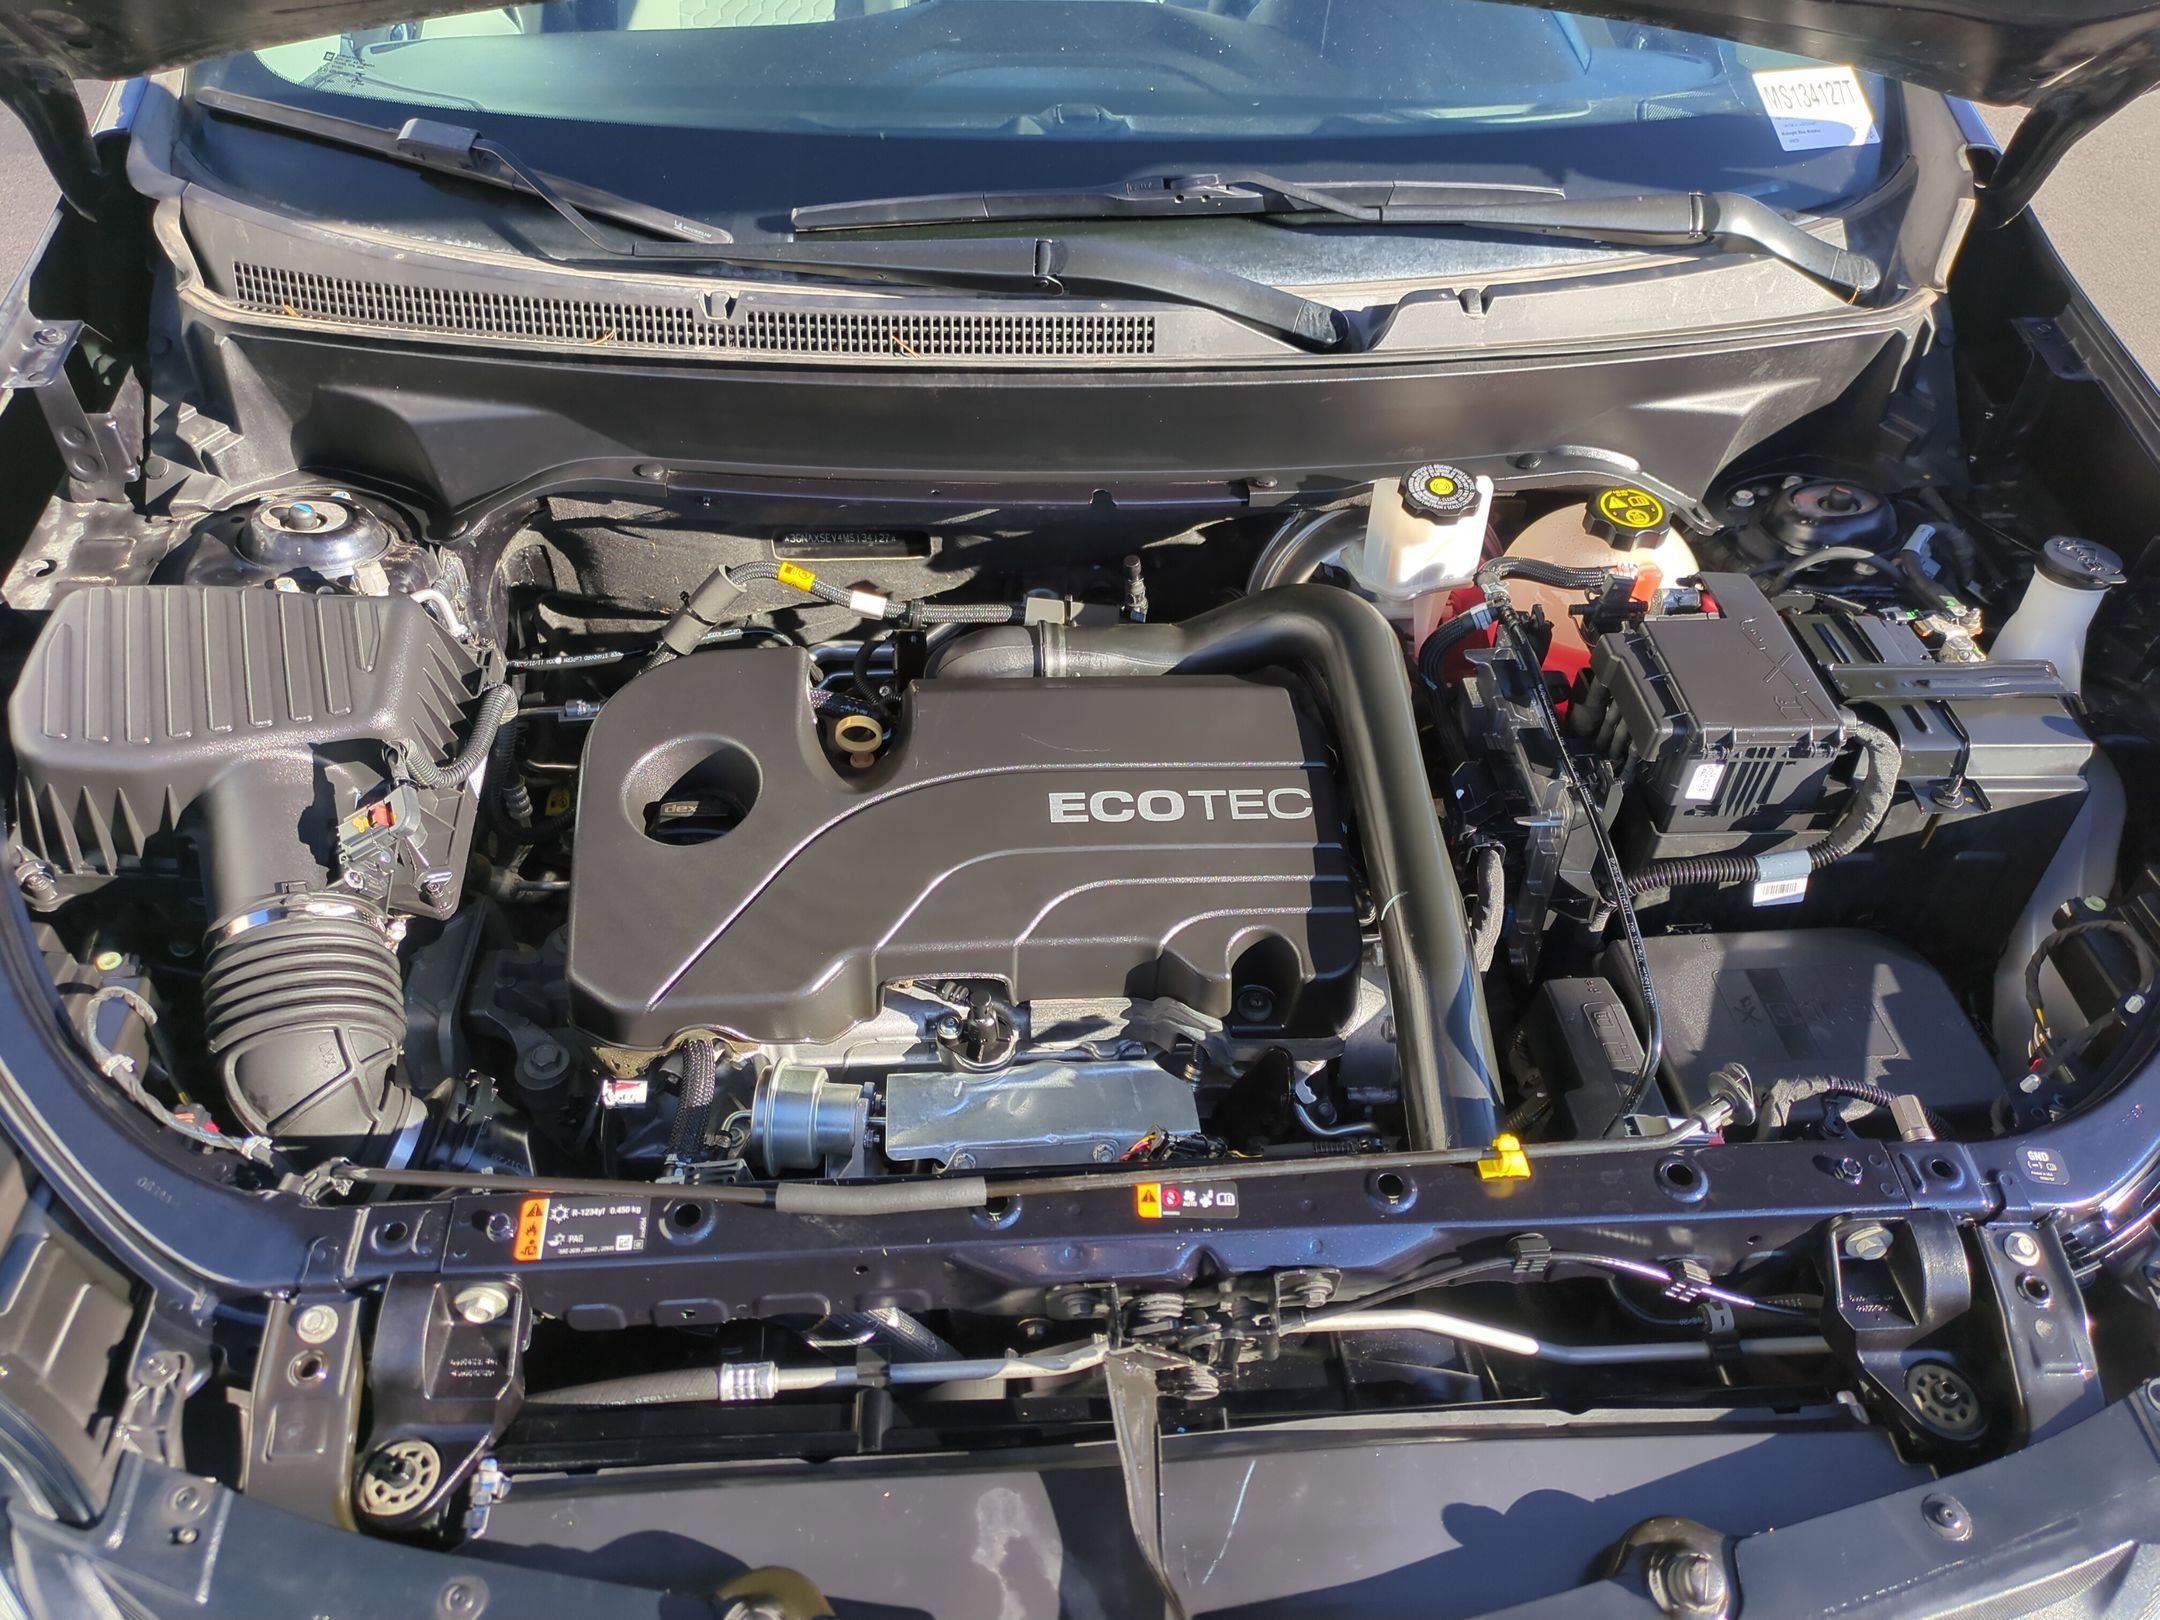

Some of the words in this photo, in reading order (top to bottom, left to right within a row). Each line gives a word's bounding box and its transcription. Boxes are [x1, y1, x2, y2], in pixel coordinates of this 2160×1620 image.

[1048, 788, 1313, 823] ECOTEC
[2027, 1150, 2049, 1162] GND
[571, 1206, 606, 1217] R-1234yf
[608, 1205, 631, 1215] 0.450
[630, 1204, 642, 1215] kg
[567, 1234, 584, 1244] PAG
